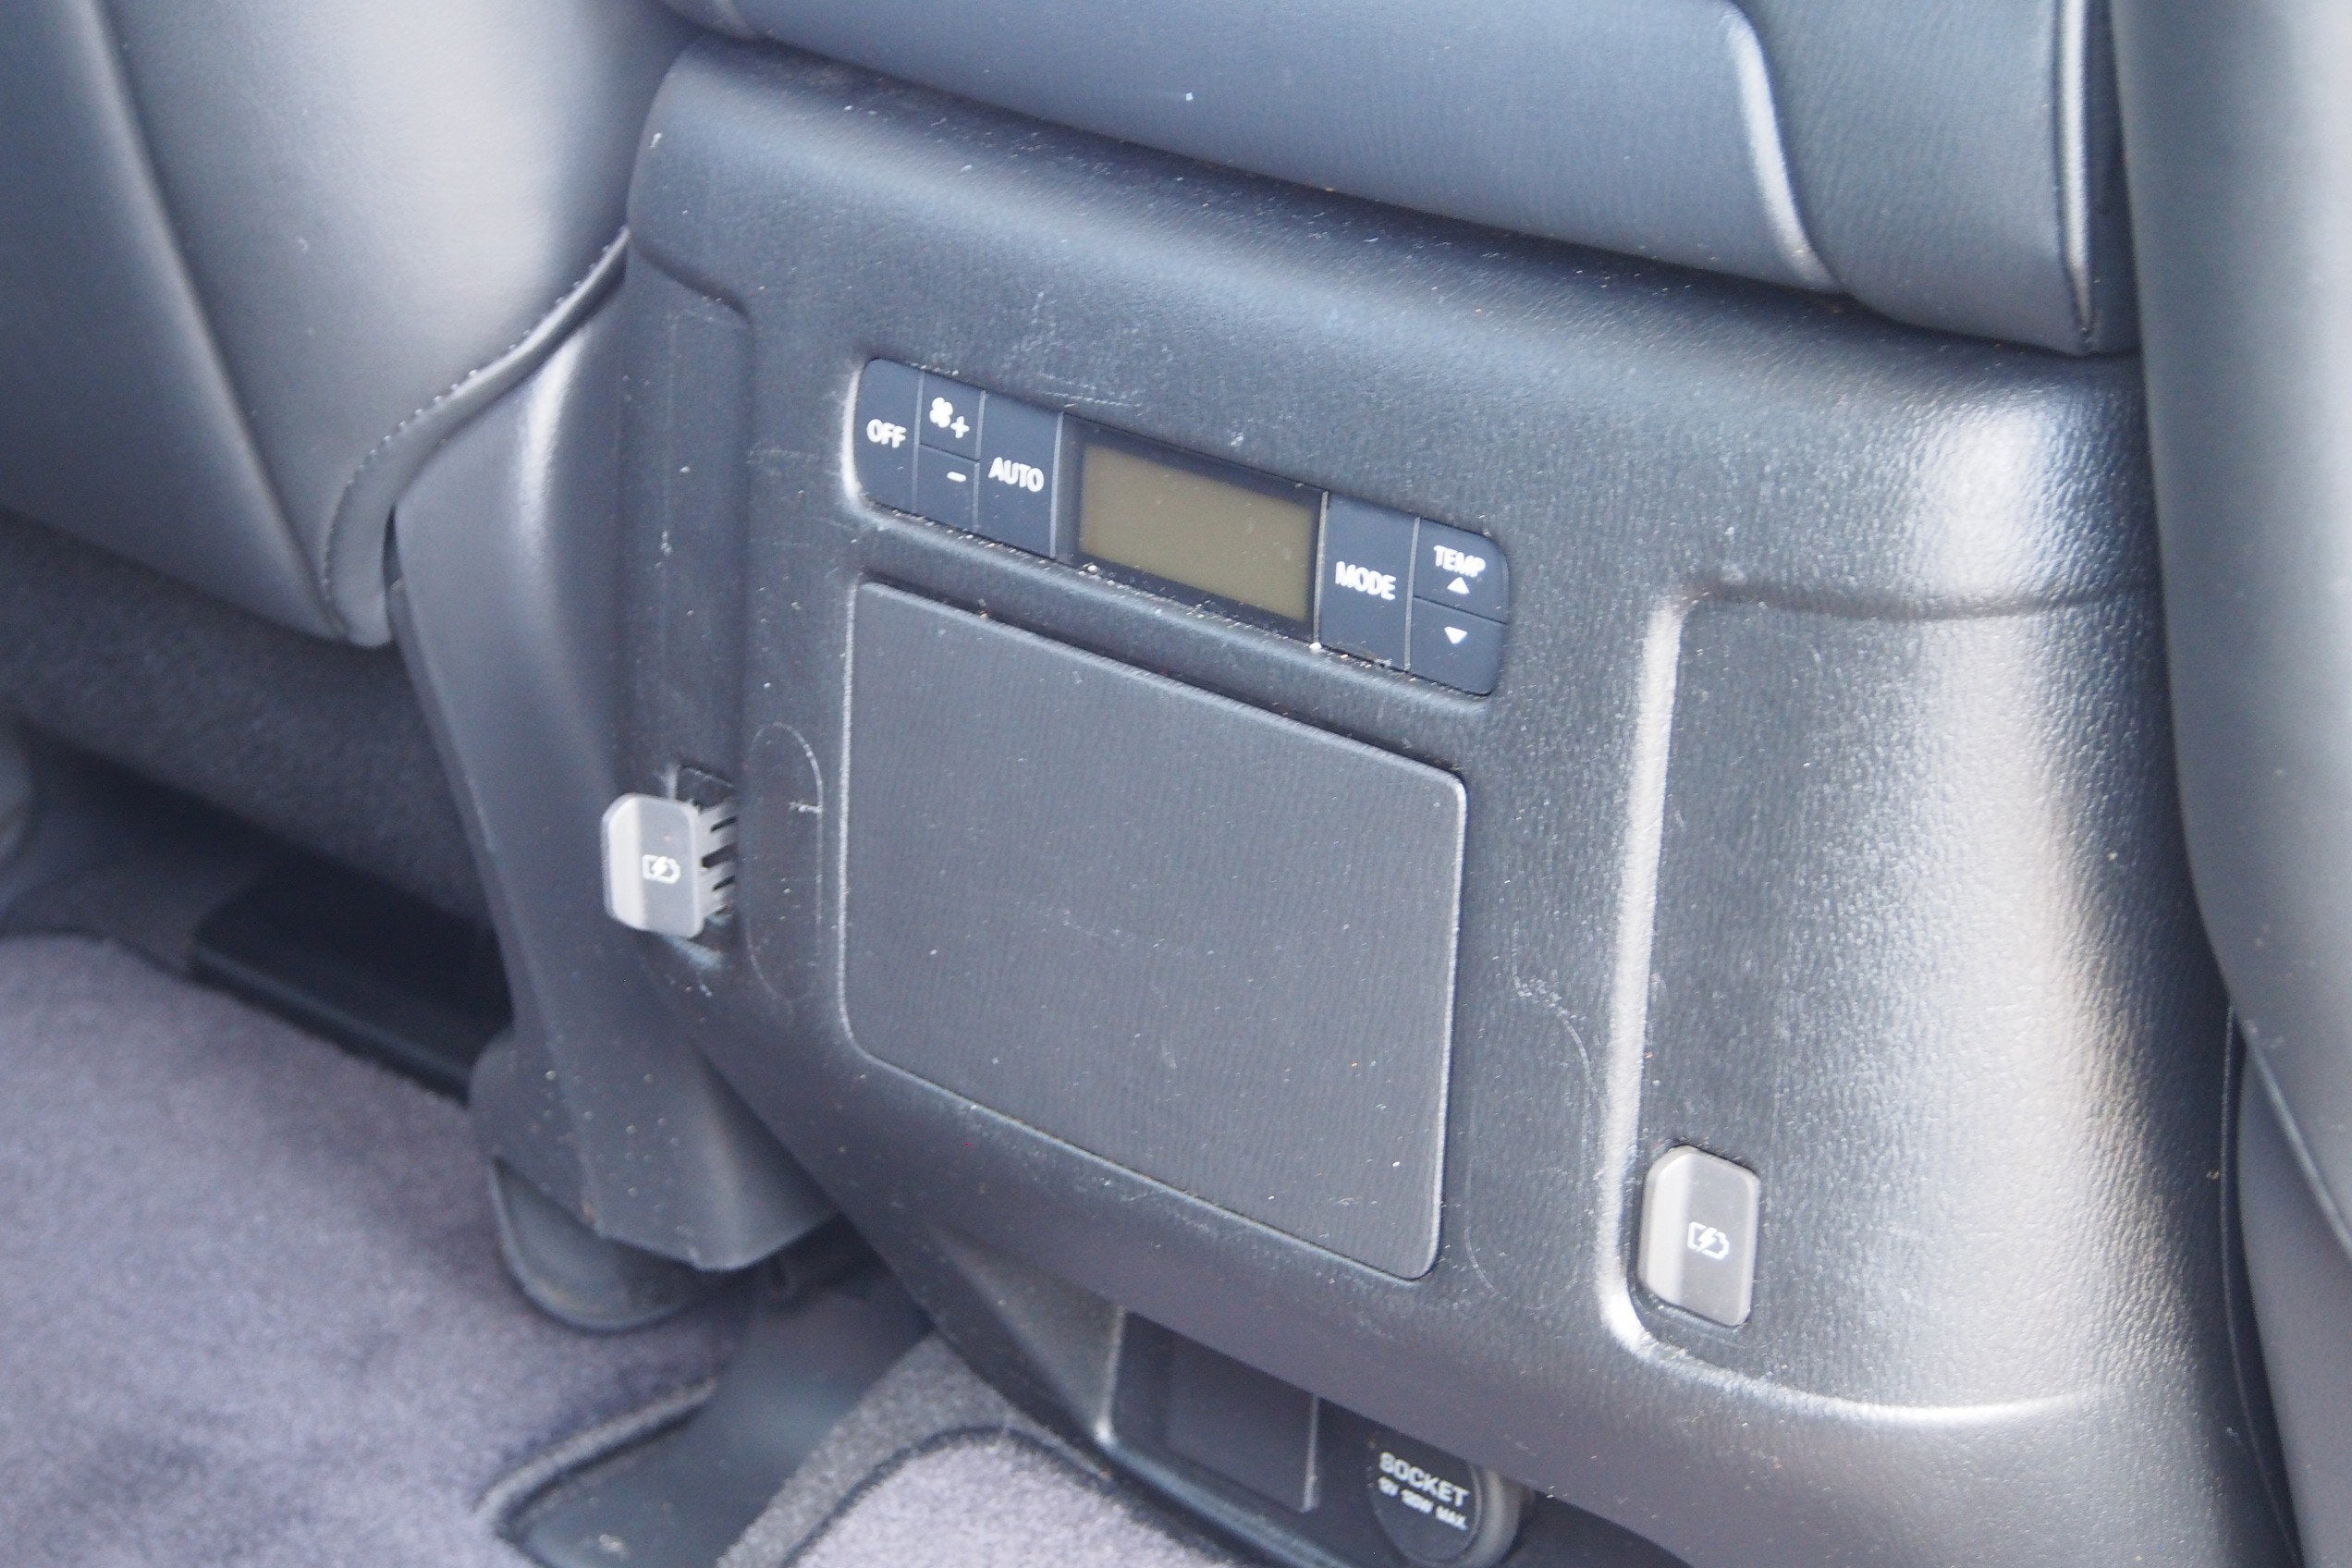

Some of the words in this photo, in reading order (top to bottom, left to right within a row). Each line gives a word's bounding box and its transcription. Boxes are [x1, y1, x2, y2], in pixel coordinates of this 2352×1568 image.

[866, 419, 907, 448] OFF
[988, 457, 1045, 492] AUTO
[1433, 545, 1487, 578] TEMP
[1335, 561, 1396, 600] MODE
[1378, 1452, 1470, 1507] SOCKET
